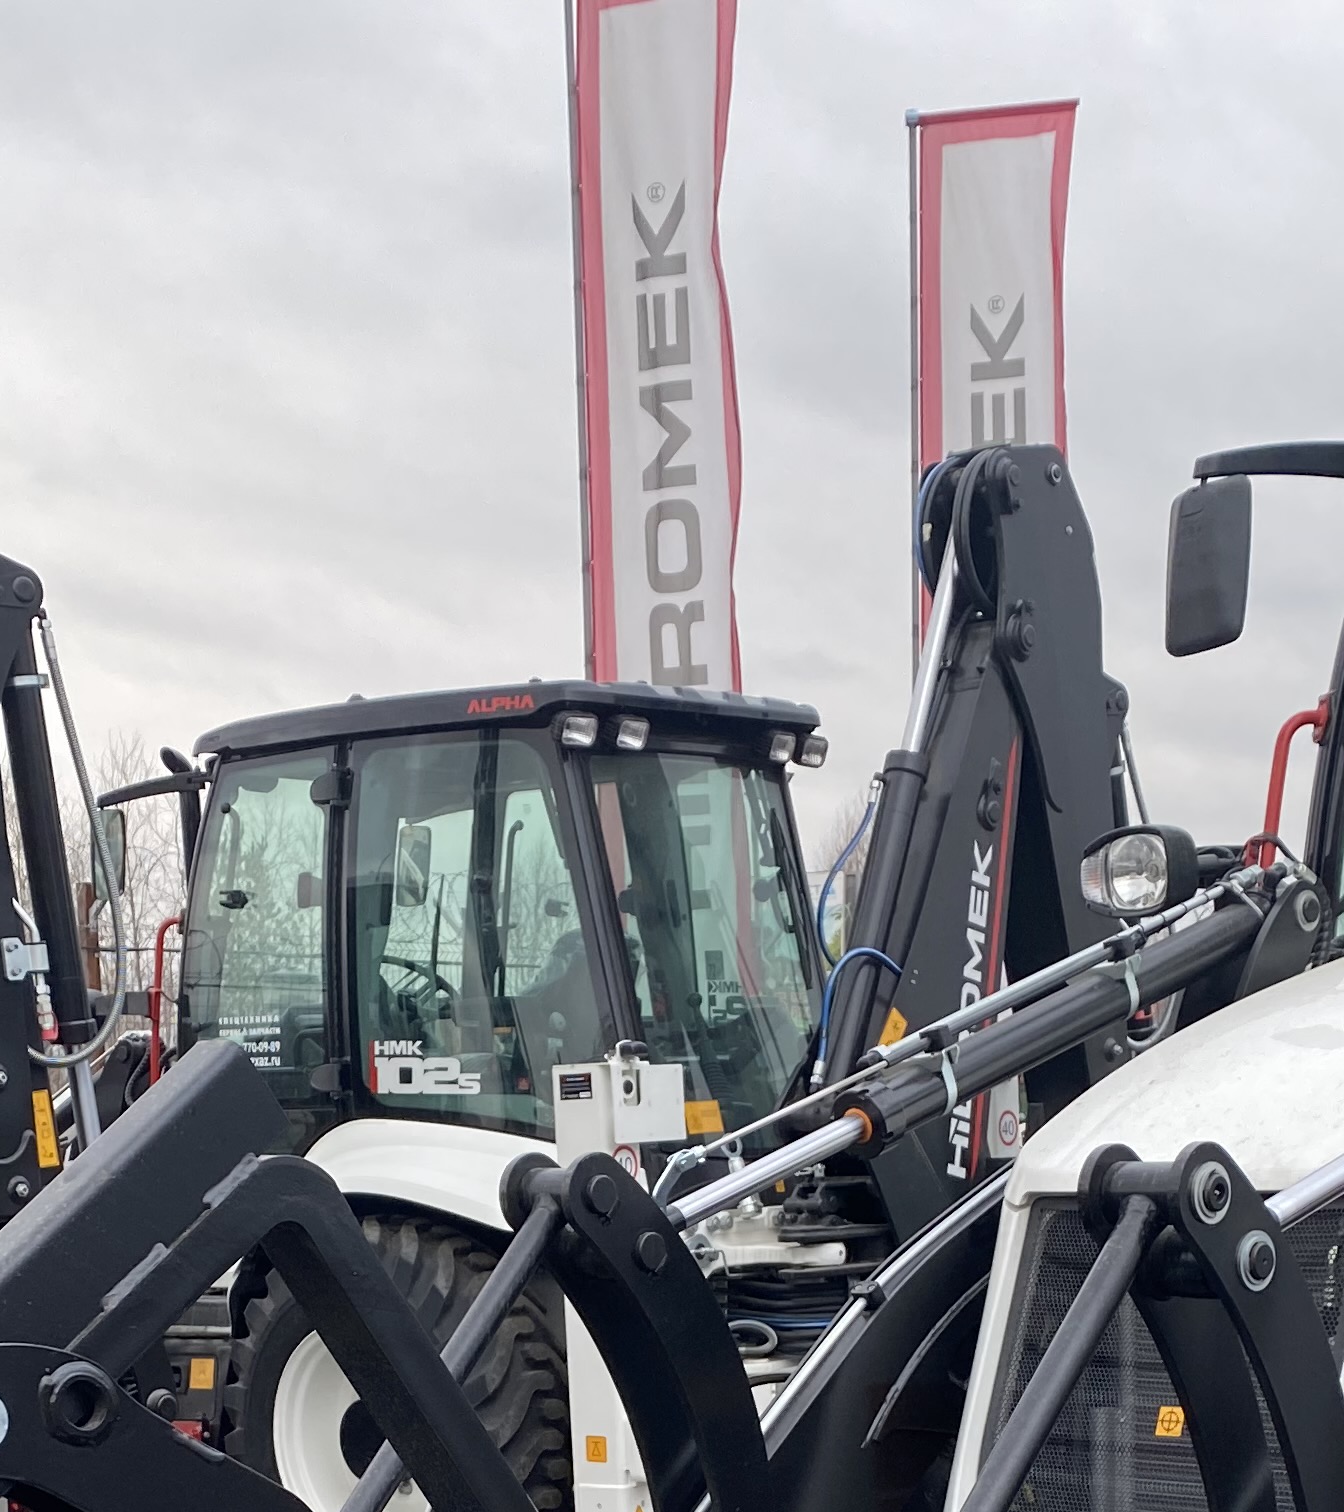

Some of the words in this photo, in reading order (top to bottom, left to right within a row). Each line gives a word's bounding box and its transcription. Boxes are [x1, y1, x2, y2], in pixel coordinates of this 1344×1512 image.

[467, 694, 535, 714] ALPHA
[374, 1041, 423, 1055] HMK
[1002, 1120, 1015, 1136] 40
